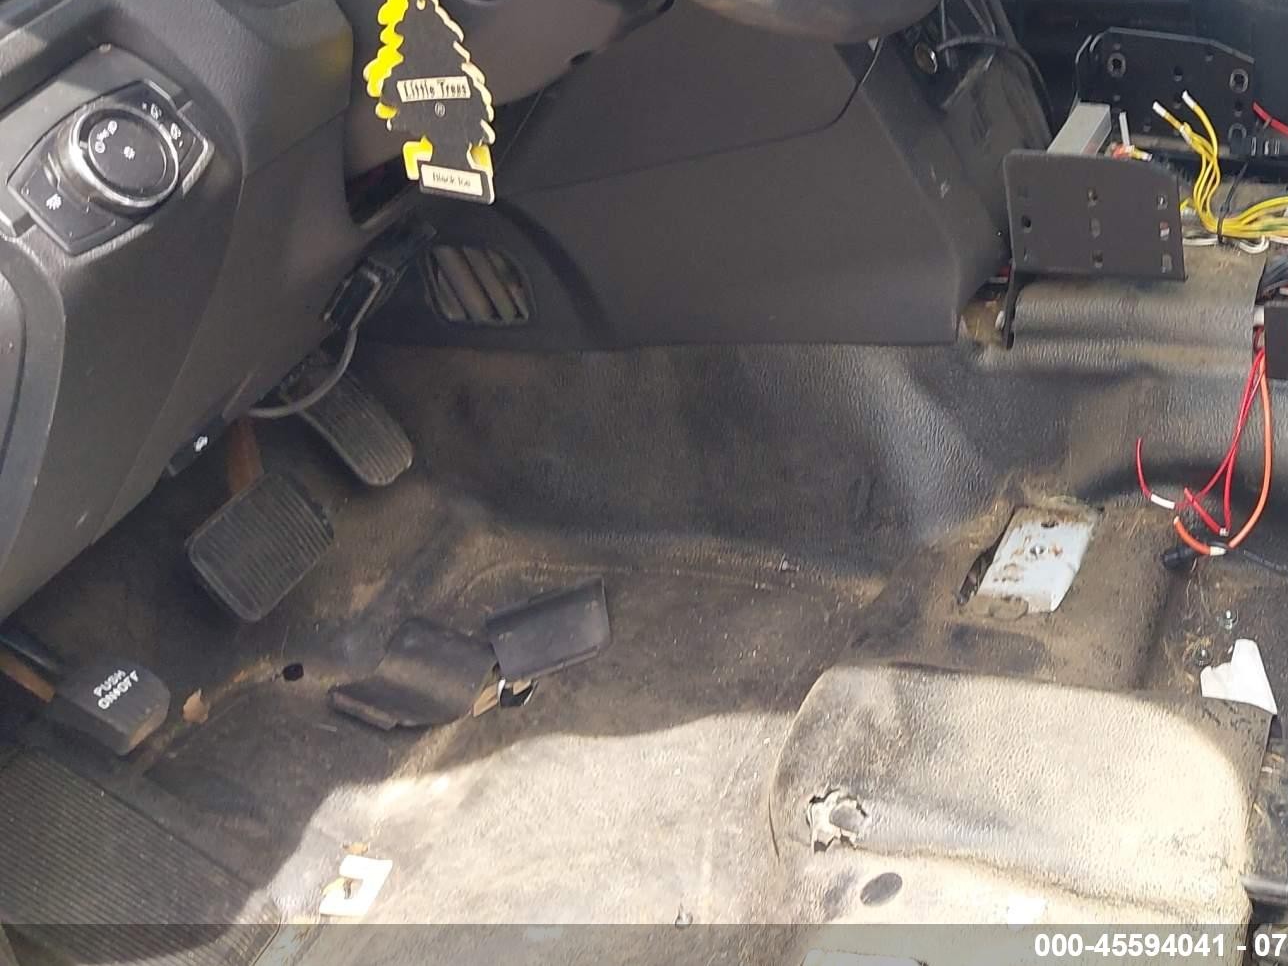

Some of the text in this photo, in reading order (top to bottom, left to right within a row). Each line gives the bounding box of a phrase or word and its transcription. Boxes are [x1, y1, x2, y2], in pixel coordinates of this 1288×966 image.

[404, 79, 467, 99] Little Trees
[93, 670, 126, 697] PUSH
